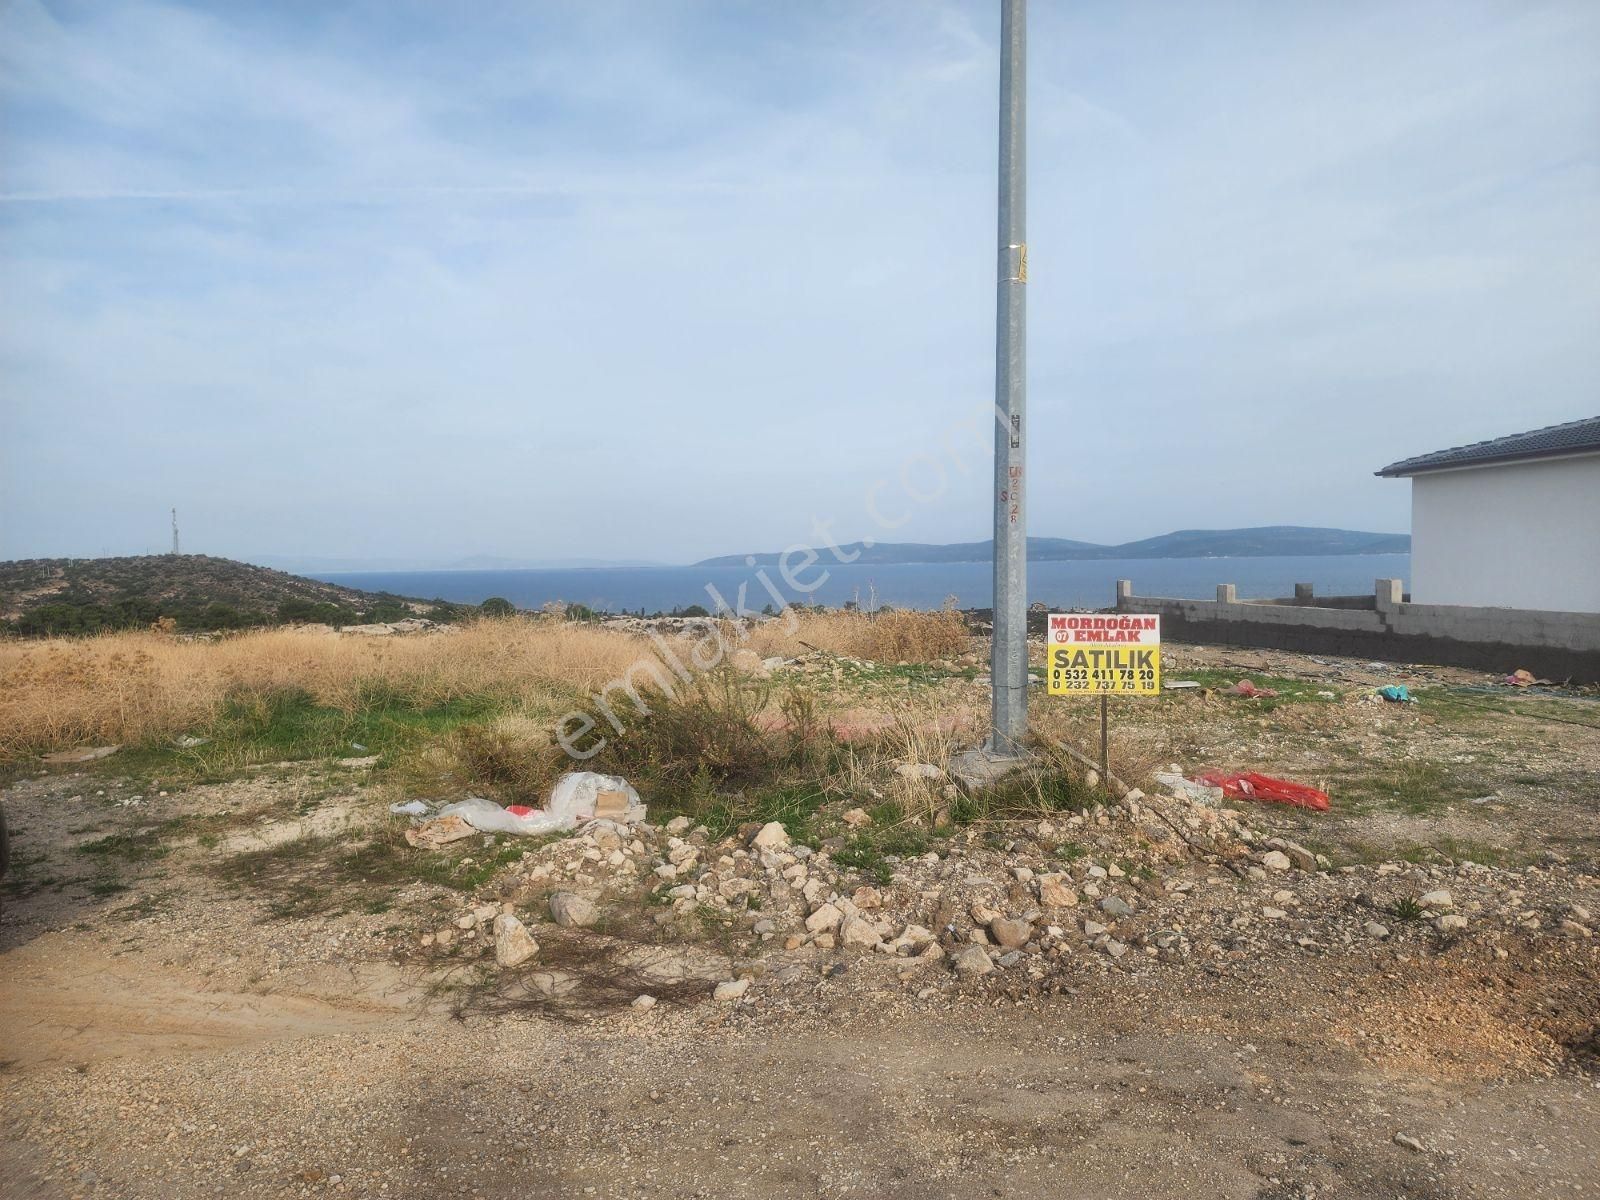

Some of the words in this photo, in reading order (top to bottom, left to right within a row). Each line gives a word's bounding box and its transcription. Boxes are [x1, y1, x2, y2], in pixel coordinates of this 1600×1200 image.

[1051, 616, 1156, 630] MORDOĞAN
[1074, 630, 1141, 642] EMLAK
[1054, 650, 1154, 669] SATILIK
[1053, 670, 1060, 680] 0
[1065, 670, 1088, 680] 532
[1092, 670, 1114, 680] 411
[1120, 670, 1134, 680] 78
[1139, 670, 1154, 680] 20
[1053, 681, 1060, 689] 0
[1066, 681, 1089, 689] 232
[1095, 681, 1116, 689] 737
[1121, 681, 1135, 689] 75
[1142, 681, 1155, 689] 19
